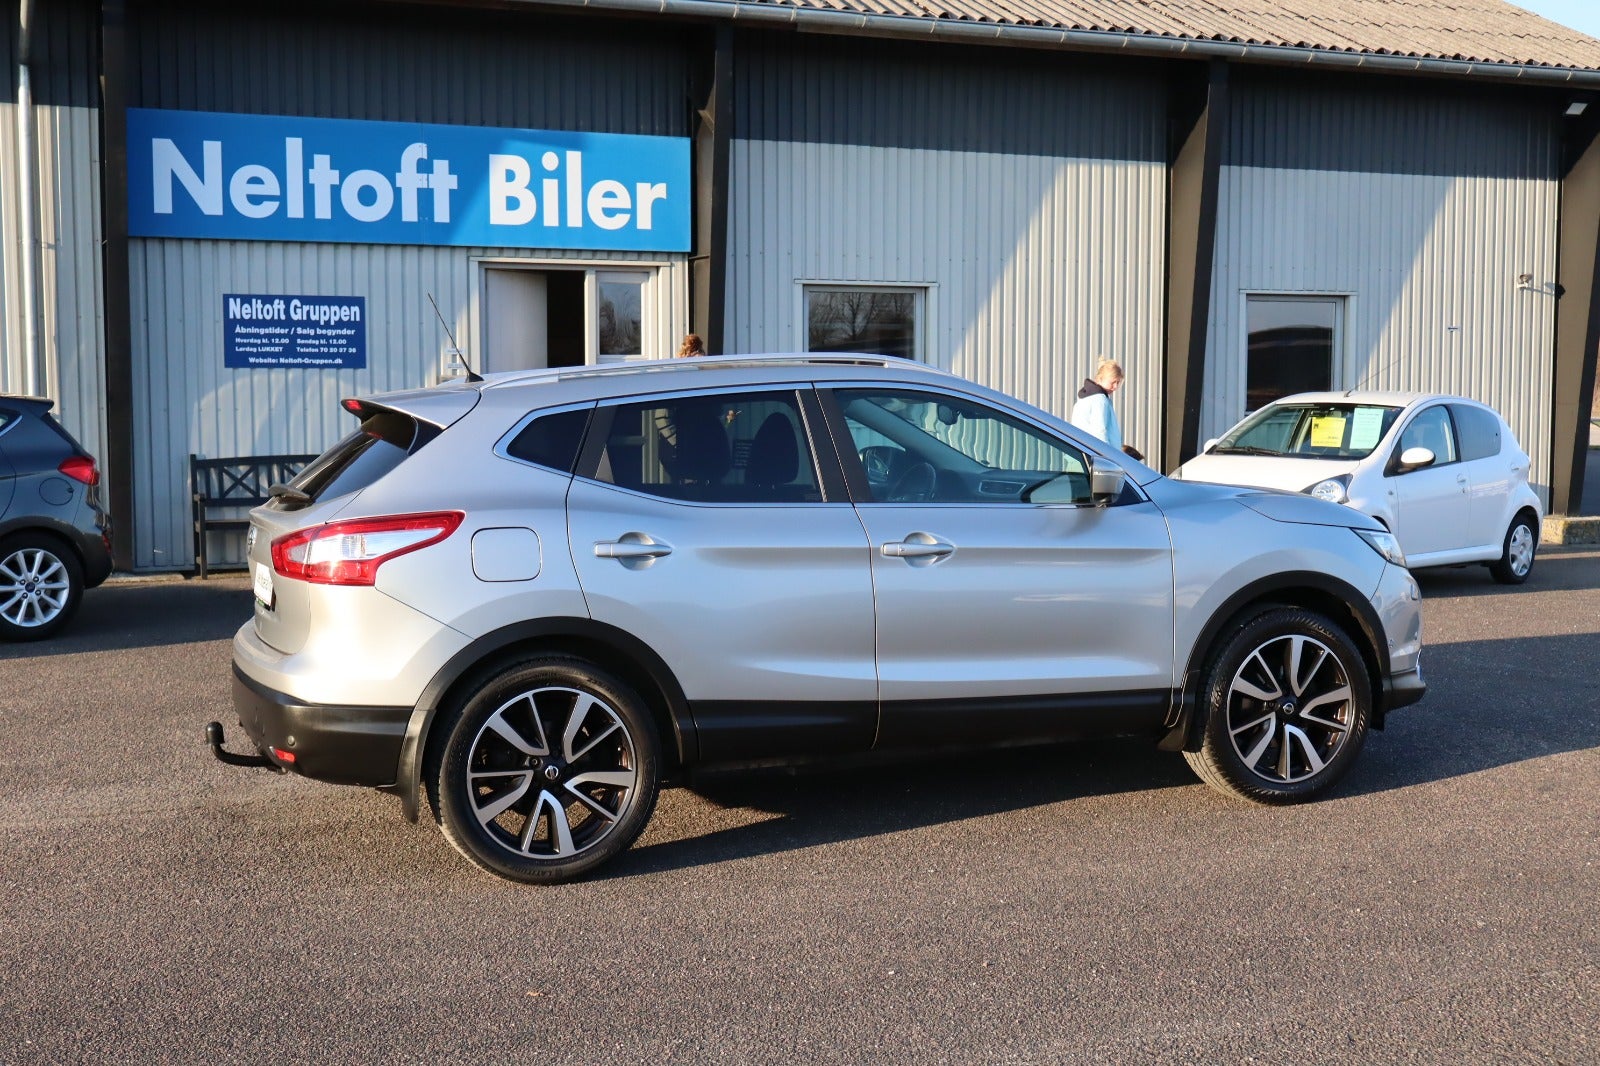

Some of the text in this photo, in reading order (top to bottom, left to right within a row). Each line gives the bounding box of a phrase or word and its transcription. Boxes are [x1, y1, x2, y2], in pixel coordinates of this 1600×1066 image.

[151, 137, 668, 231] Neltoft Biler
[229, 297, 360, 325] Neltoft Gruppen
[235, 324, 355, 336] Åbningstider / Salg begynder
[235, 337, 261, 345] Hverdag
[279, 357, 343, 365] Neltoft-Gruppen.dk
